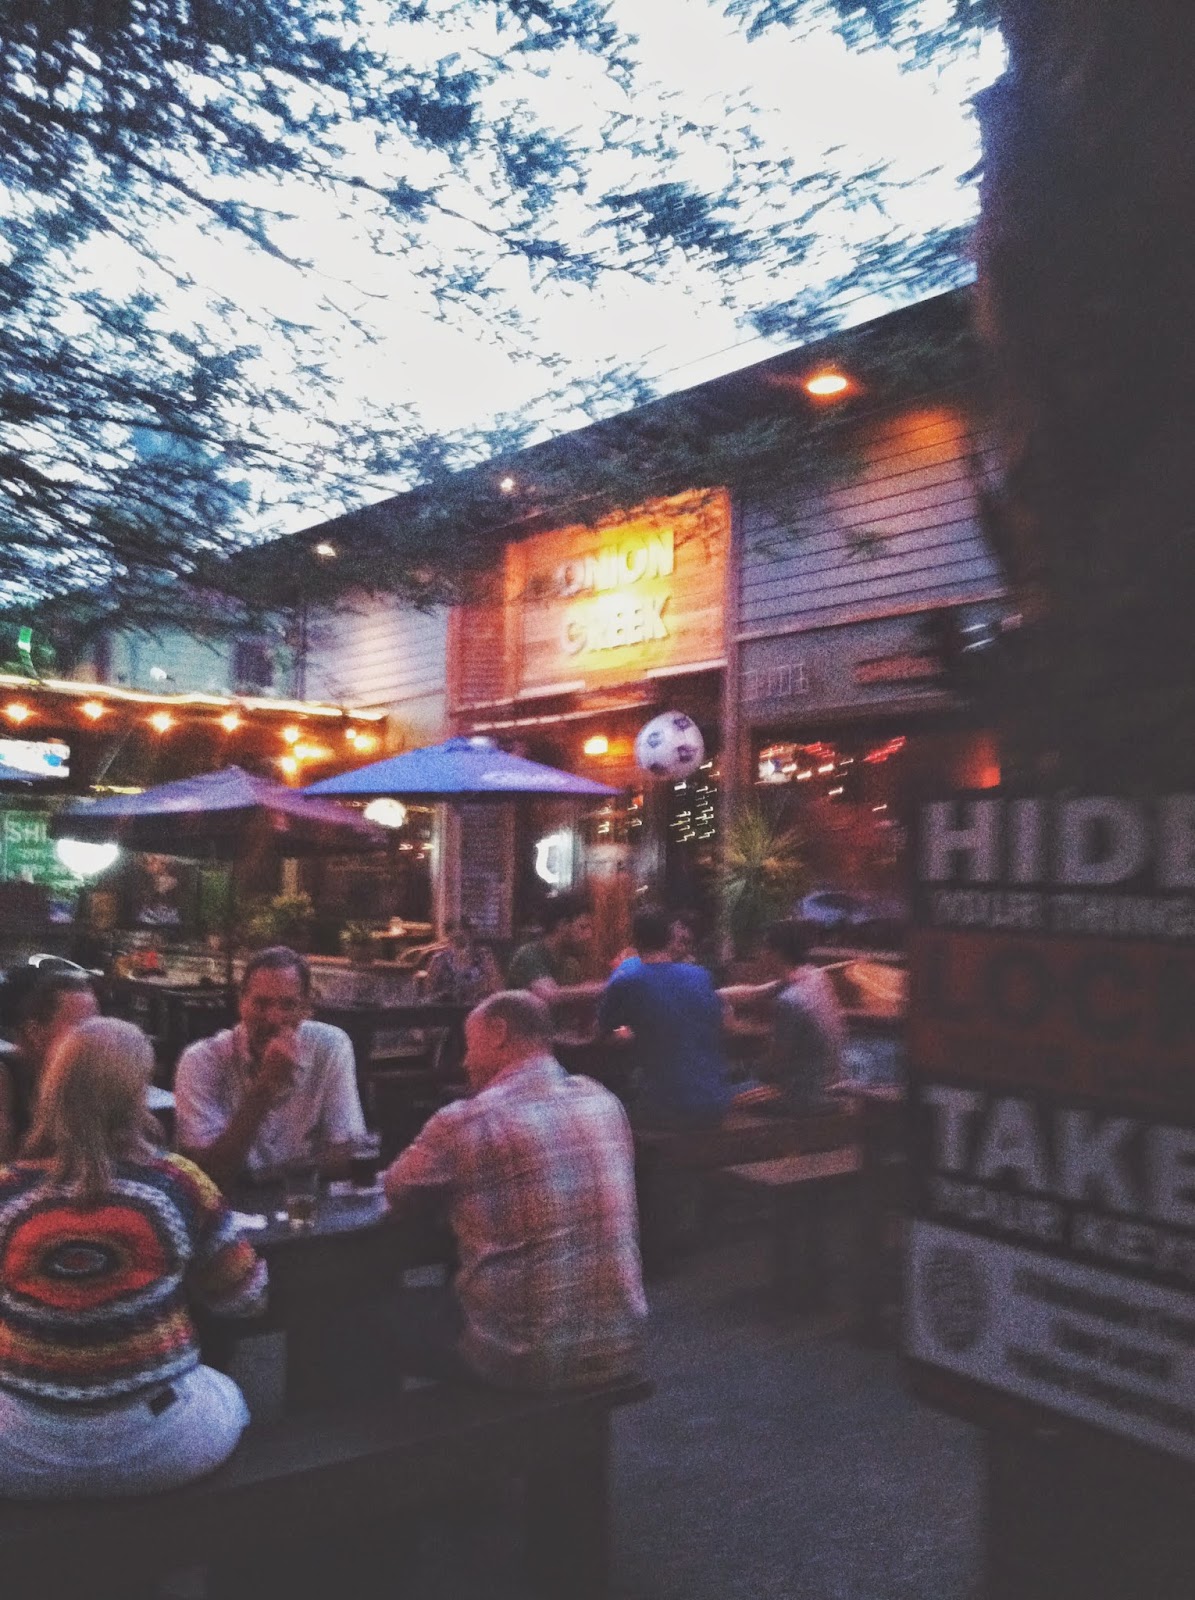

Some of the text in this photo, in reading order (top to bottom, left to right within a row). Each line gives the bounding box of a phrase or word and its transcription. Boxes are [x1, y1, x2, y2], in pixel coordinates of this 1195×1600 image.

[554, 528, 675, 597] ONION
[559, 592, 672, 656] CREEK
[922, 795, 1195, 887] HIDE
[922, 1085, 1195, 1218] TAKE
